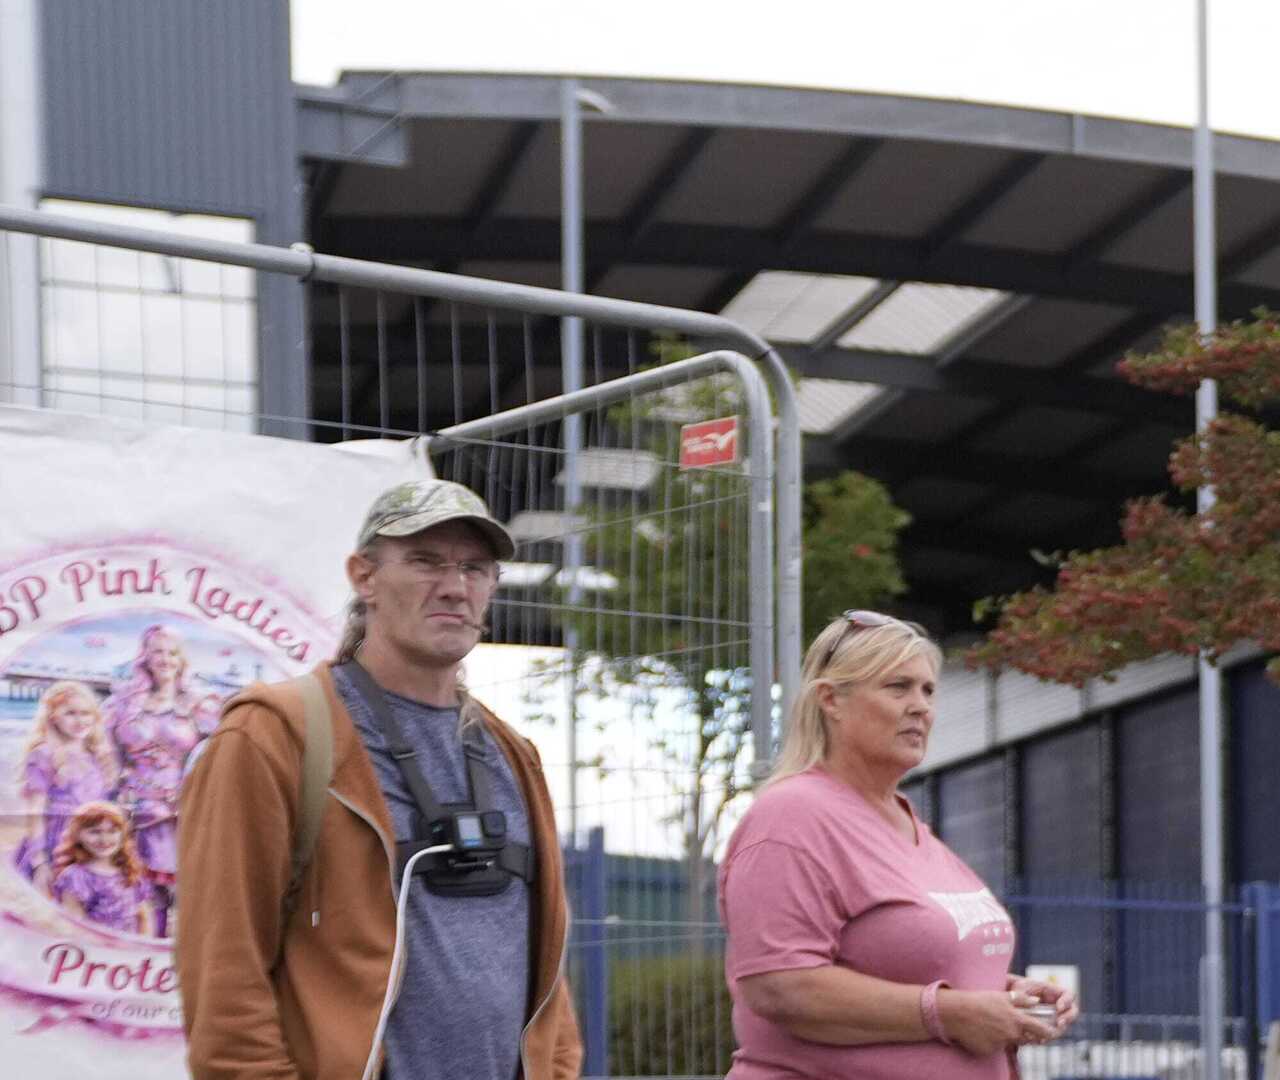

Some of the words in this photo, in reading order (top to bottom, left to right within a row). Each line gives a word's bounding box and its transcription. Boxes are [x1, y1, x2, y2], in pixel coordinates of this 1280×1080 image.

[59, 559, 172, 602] Pink
[185, 566, 311, 664] Ladies
[42, 943, 178, 993] Prote
